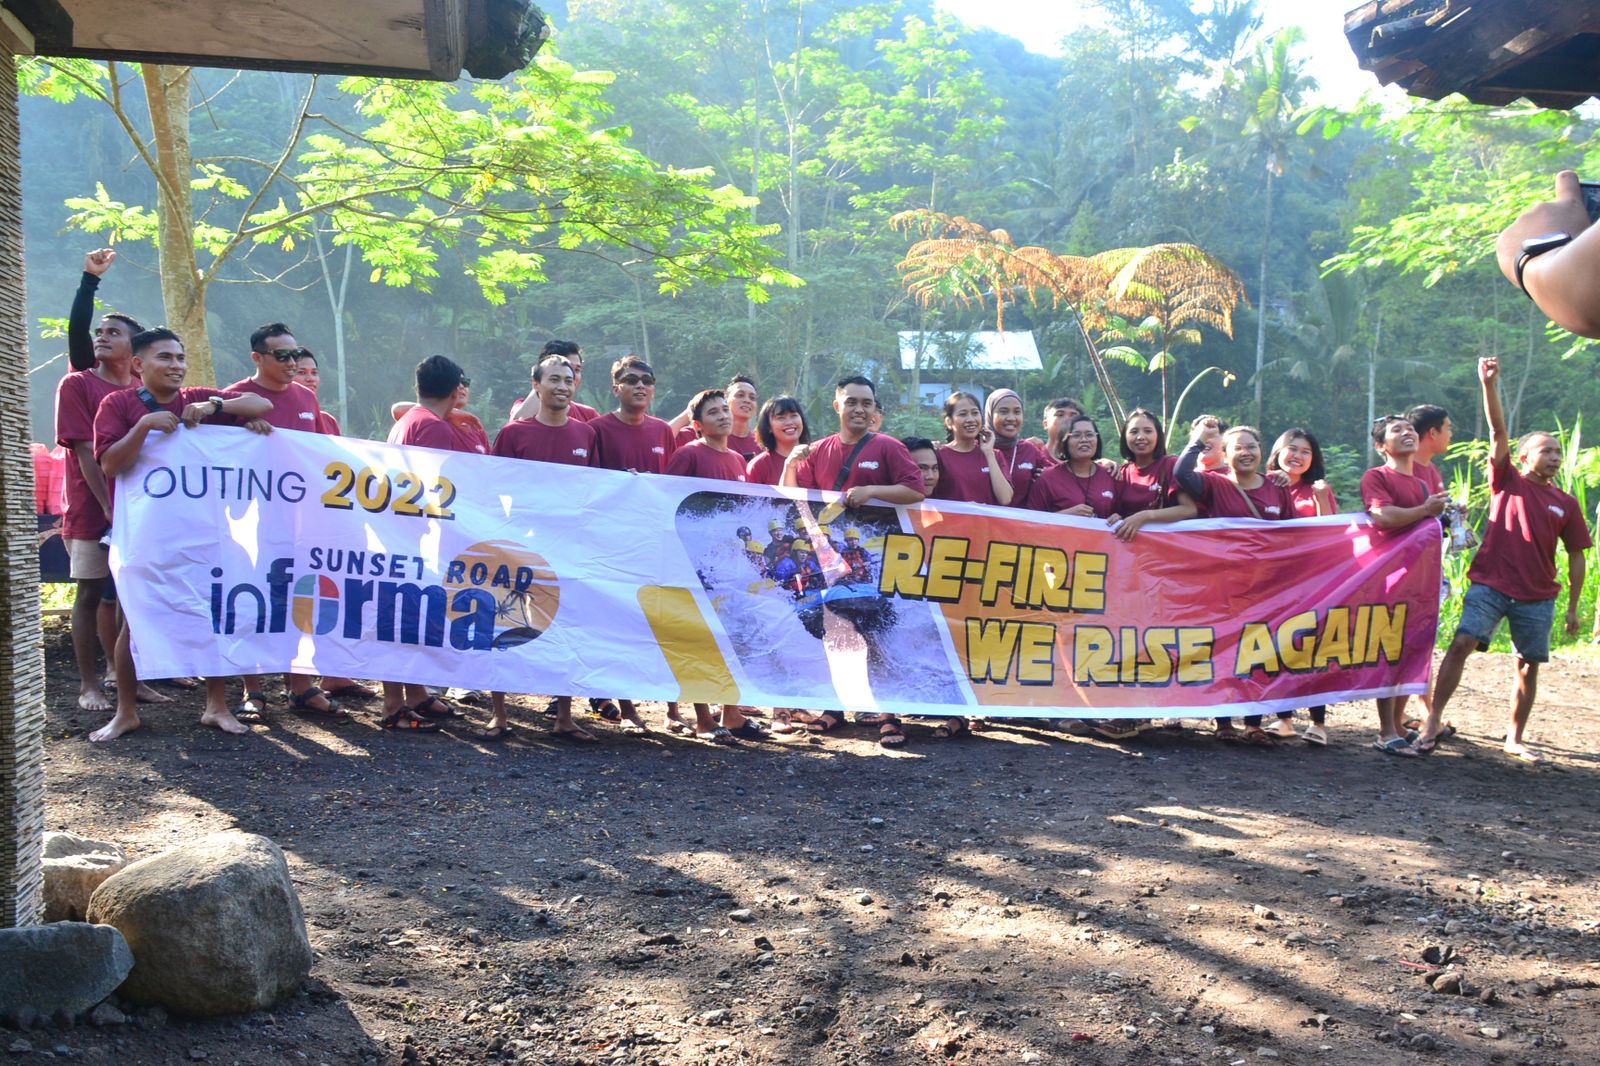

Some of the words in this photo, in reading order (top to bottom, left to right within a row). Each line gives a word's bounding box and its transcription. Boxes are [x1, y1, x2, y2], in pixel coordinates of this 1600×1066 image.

[143, 466, 306, 503] OUTING
[320, 461, 456, 521] 2022
[210, 557, 493, 651] informa
[309, 546, 425, 581] SUNSET
[446, 559, 534, 589] ROAD
[878, 534, 1107, 613] RE-FIRE
[965, 617, 1056, 686] WE
[1072, 625, 1214, 687] RISE
[1235, 603, 1408, 677] AGAIN
